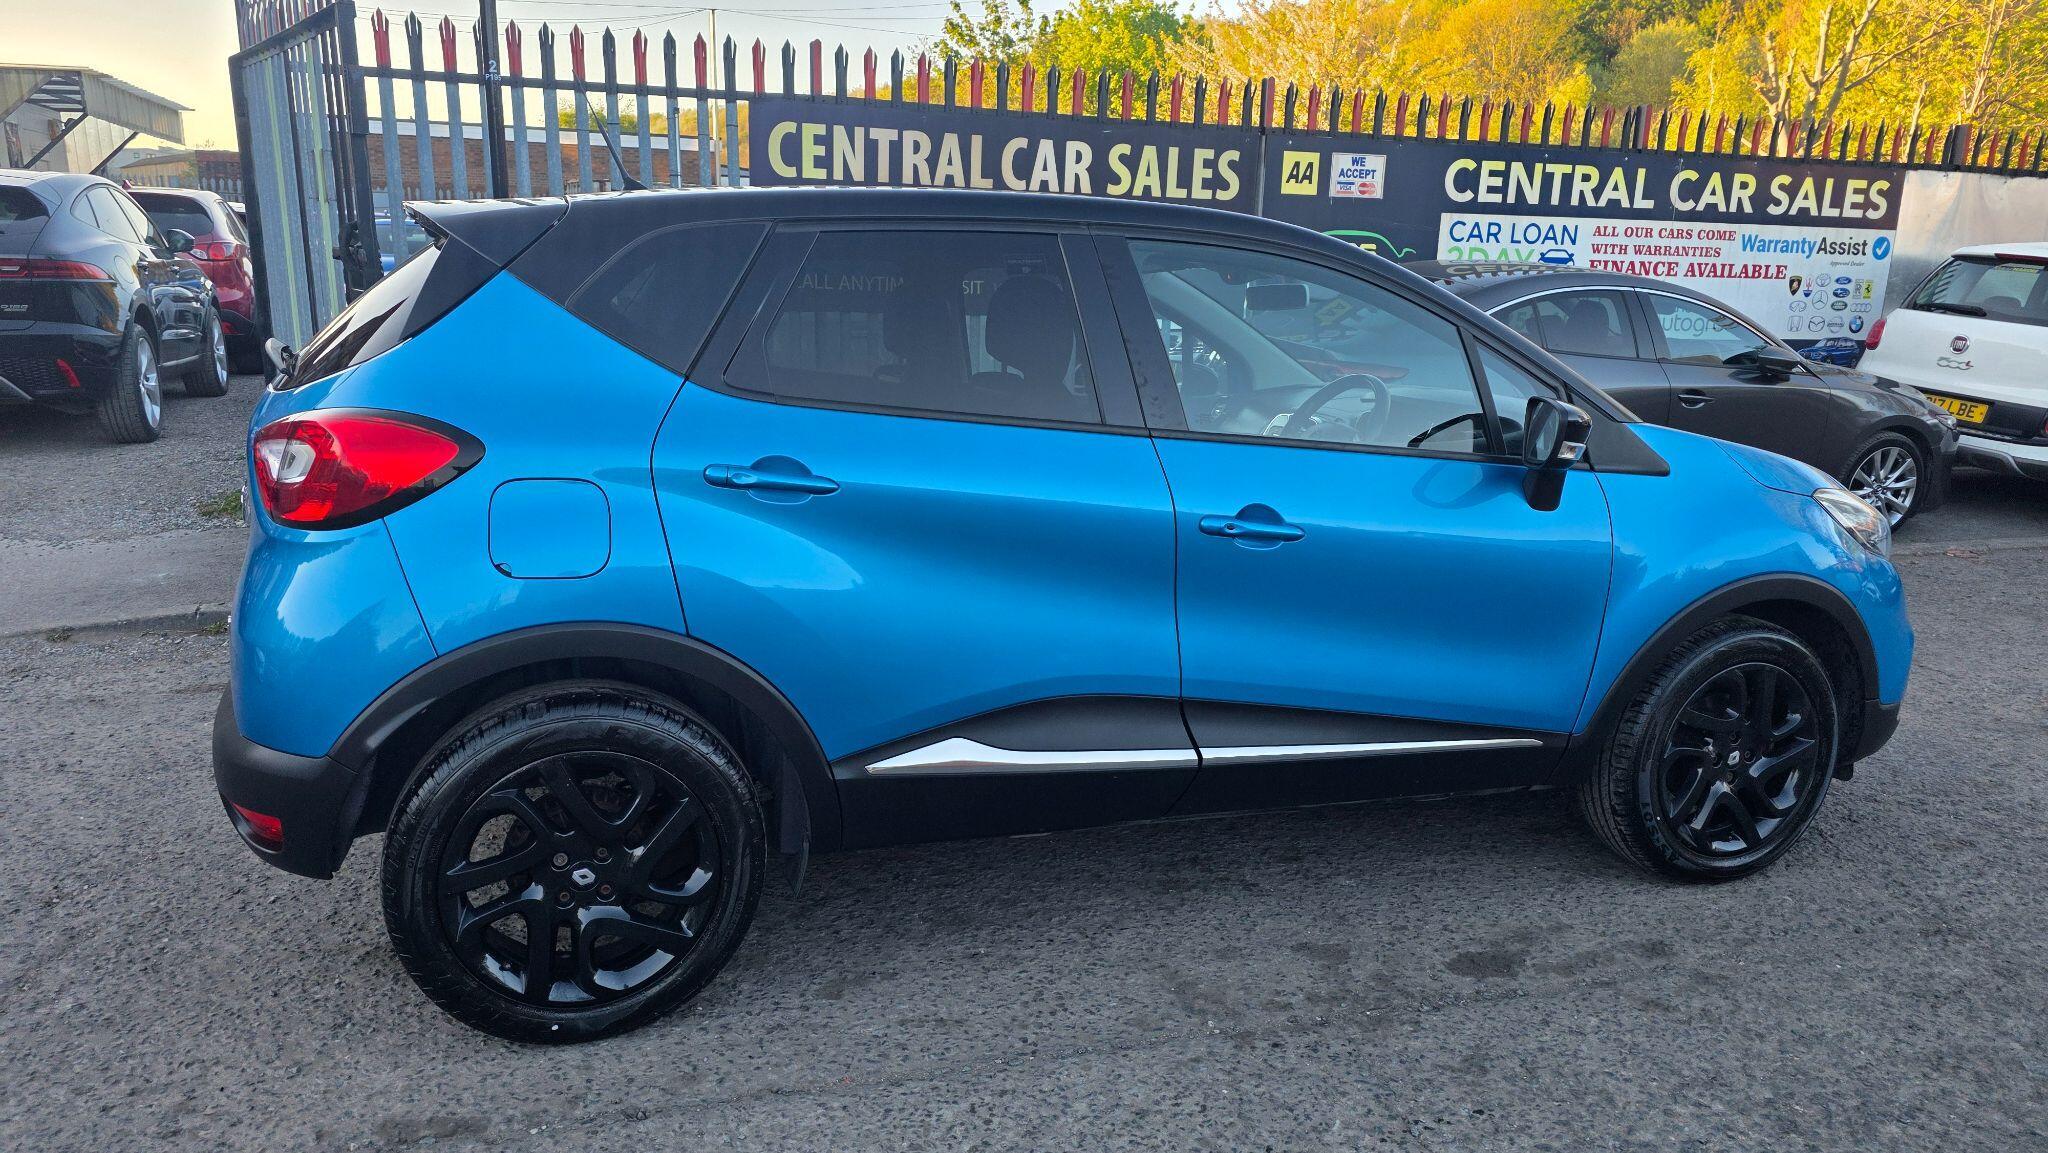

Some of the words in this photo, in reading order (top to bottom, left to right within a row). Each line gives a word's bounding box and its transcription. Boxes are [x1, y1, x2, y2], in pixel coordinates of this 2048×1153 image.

[488, 60, 498, 73] 2
[767, 120, 994, 190] CENTRAL
[1001, 136, 1093, 195] CAR
[1105, 143, 1241, 201] SALES
[1351, 156, 1367, 167] WE
[1285, 161, 1314, 185] AA
[1338, 167, 1377, 180] ACCEPT
[1444, 158, 1655, 210] CENTRAL
[1669, 168, 1757, 213] CAR
[1766, 174, 1891, 220] SALES
[1449, 220, 1502, 244] CAR
[1510, 222, 1579, 246] LOAN
[1592, 225, 1619, 238] ALL
[1623, 226, 1654, 239] OUR
[1658, 227, 1693, 240] CARS
[1697, 229, 1737, 242] COME
[1591, 242, 1629, 255] WITH
[1633, 244, 1722, 258] WARRANTIES
[1588, 259, 1679, 278] FINANCE
[1683, 262, 1789, 280] AVAILABLE
[798, 272, 834, 290] ALL
